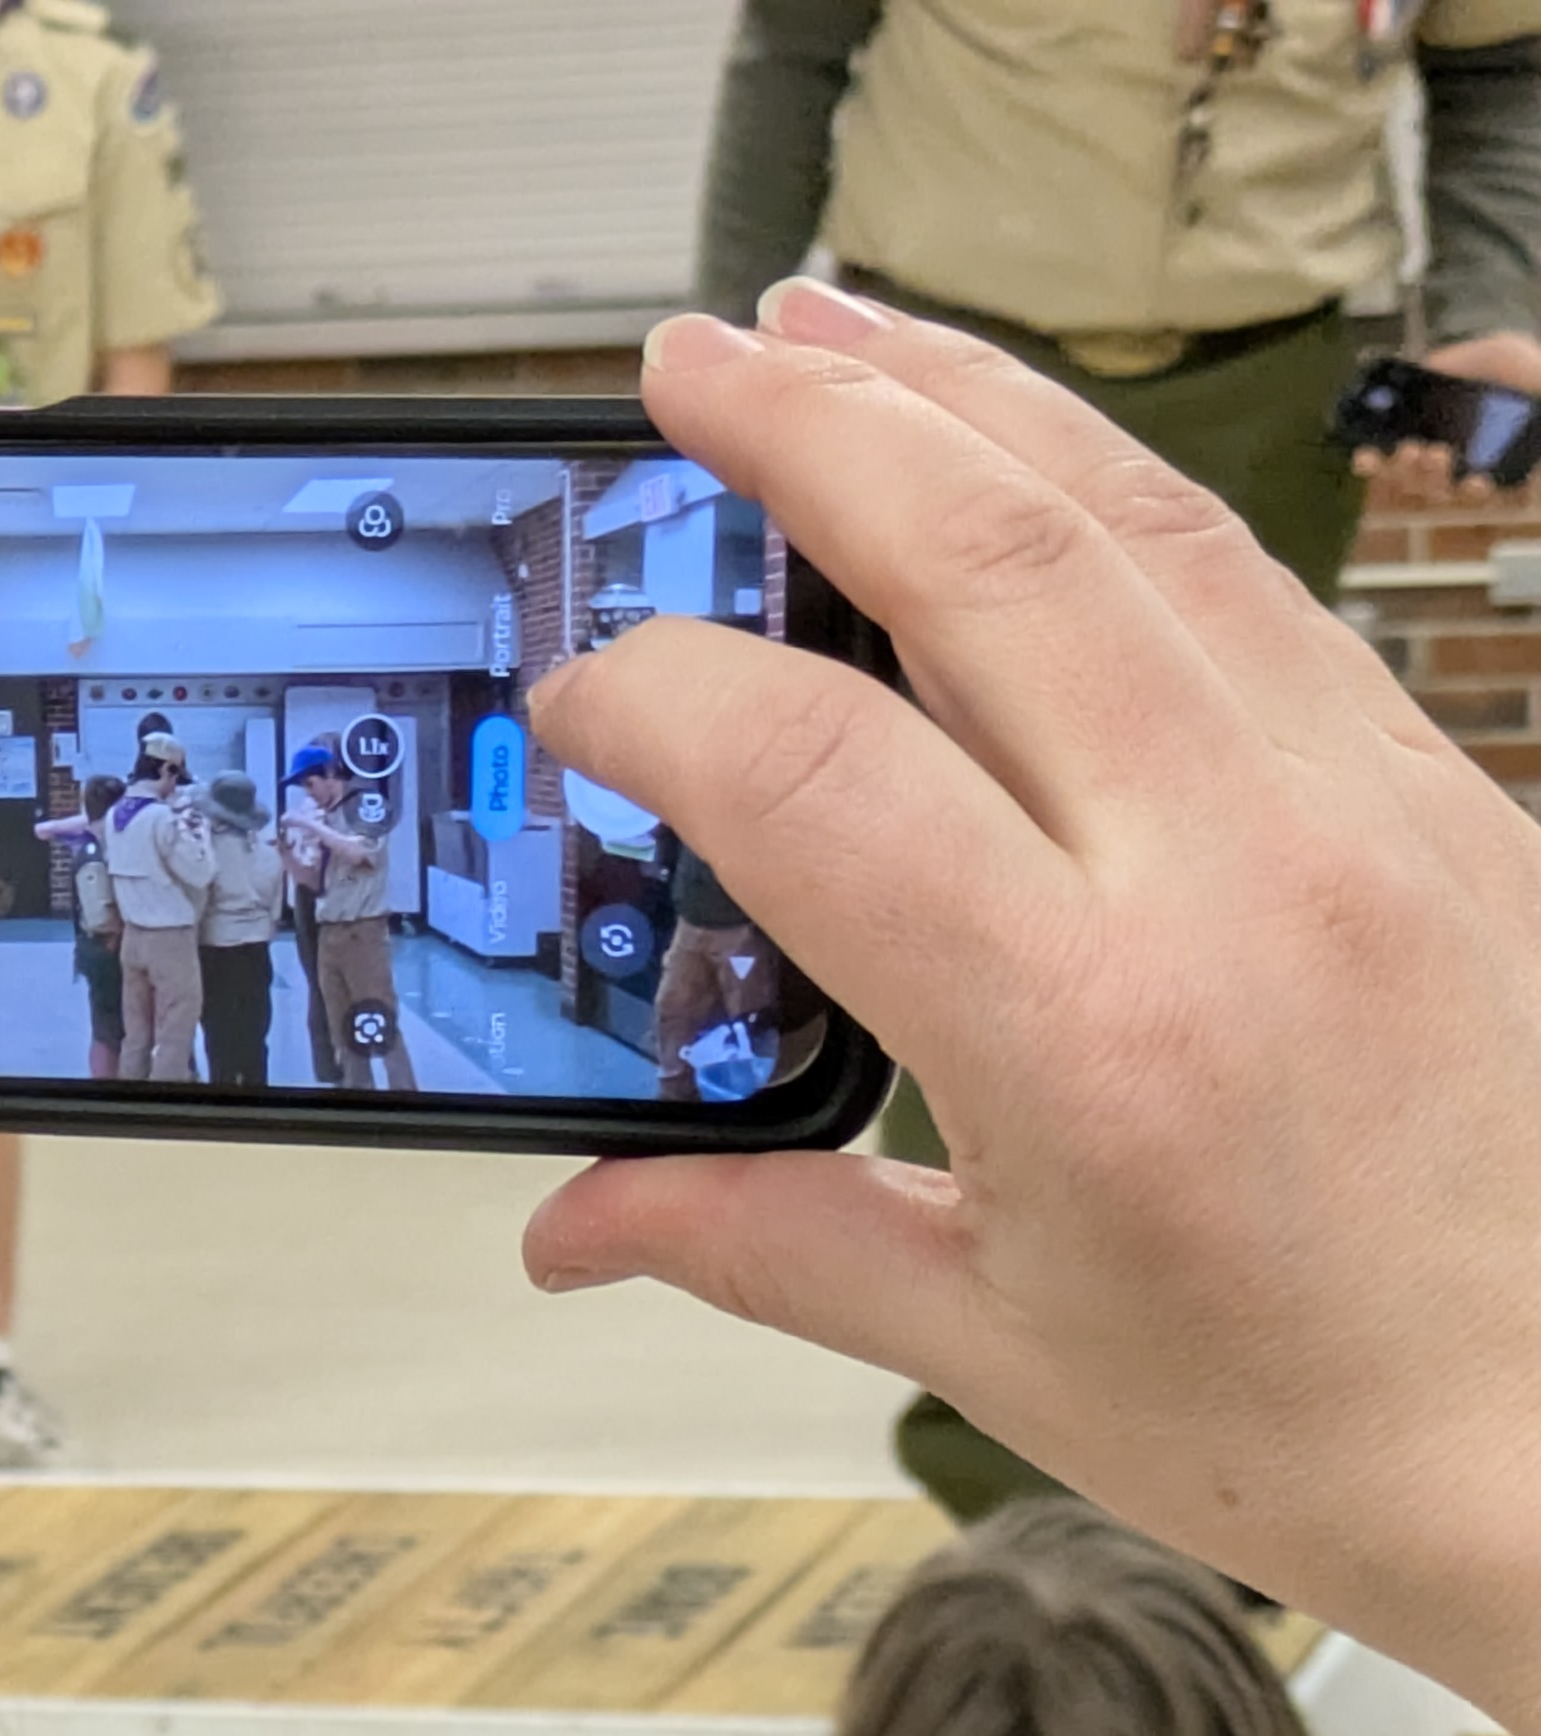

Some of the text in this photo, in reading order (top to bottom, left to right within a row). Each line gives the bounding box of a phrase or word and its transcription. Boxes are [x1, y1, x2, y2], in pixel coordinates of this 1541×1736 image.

[489, 593, 512, 679] Portrait
[488, 745, 510, 812] Photo
[489, 879, 509, 945] Video
